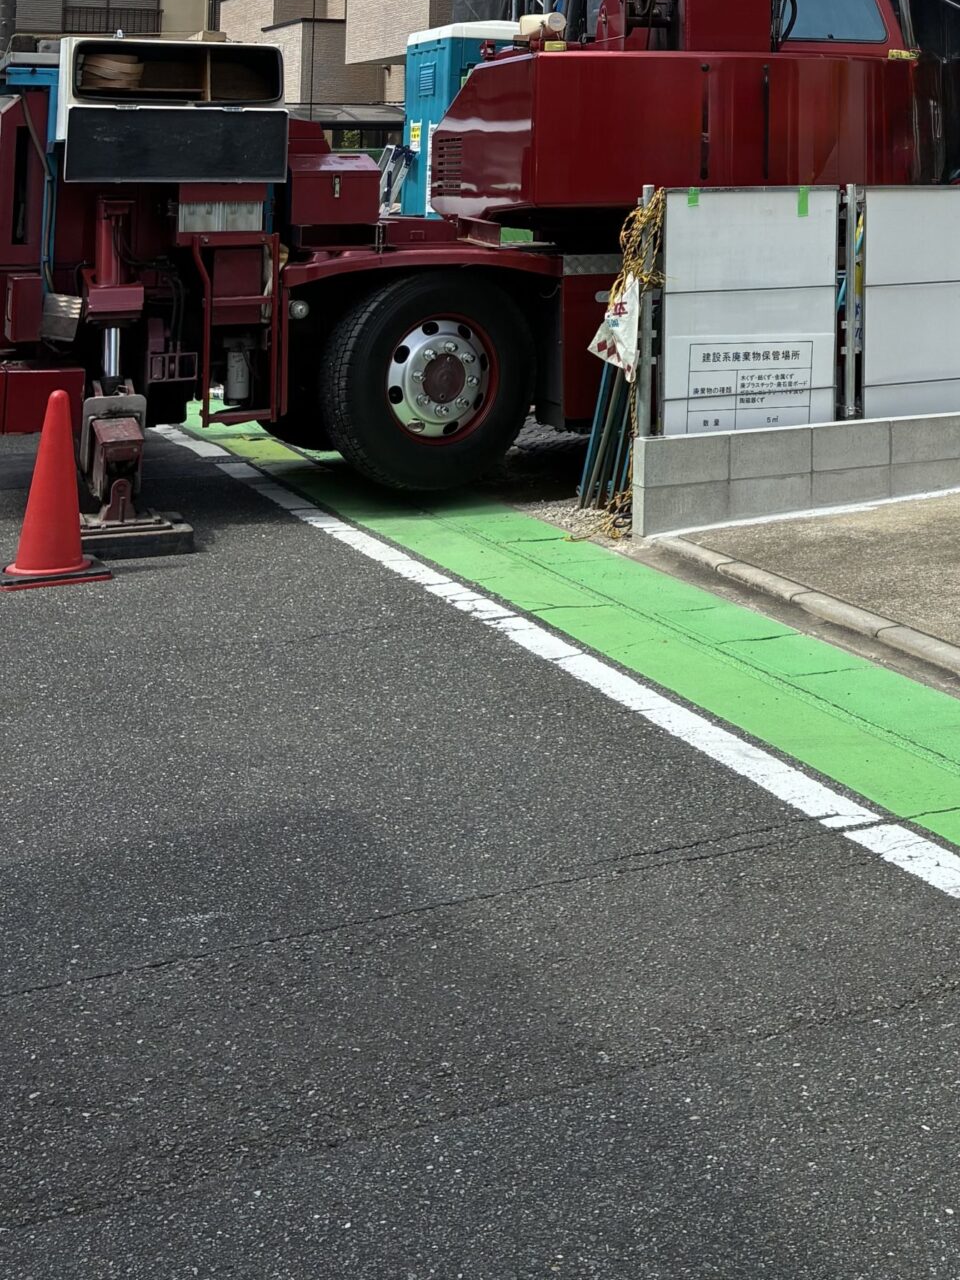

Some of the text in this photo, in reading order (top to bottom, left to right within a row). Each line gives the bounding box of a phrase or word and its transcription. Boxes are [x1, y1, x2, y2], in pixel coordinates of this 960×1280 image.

[702, 350, 800, 362] 建設系廃棄物保管場所
